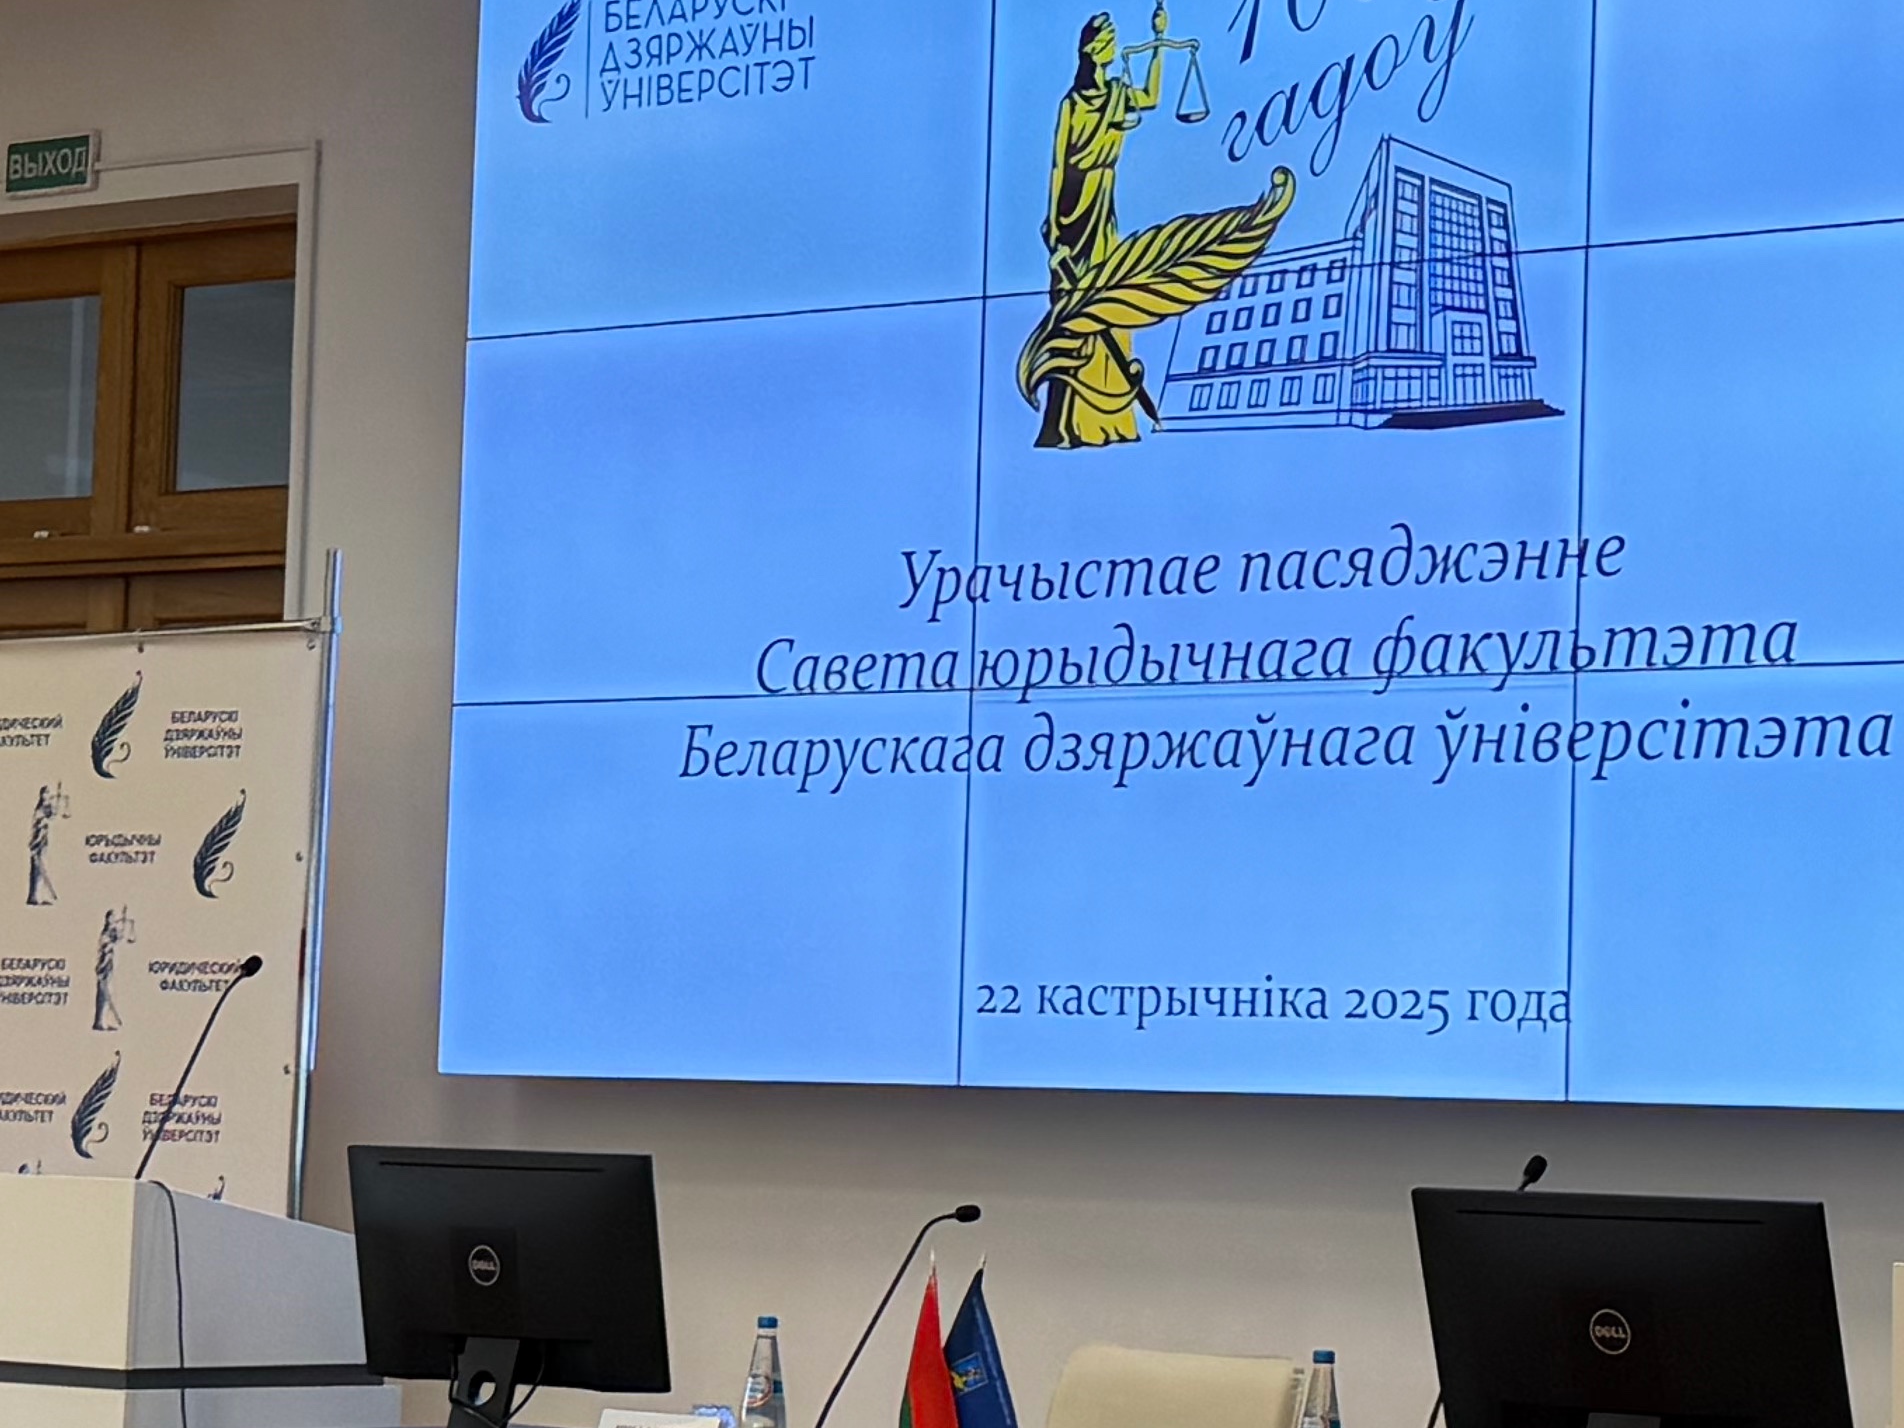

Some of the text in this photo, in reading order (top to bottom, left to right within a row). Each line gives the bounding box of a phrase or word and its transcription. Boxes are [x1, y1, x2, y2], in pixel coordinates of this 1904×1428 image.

[599, 14, 815, 77] ДЗЯРЖАЎНЫ
[599, 55, 817, 113] ЎНІВЕРСІТЭТ
[8, 145, 88, 180] ВЫХОД
[898, 522, 1627, 624] Урачыстае пасяджэнне
[755, 614, 1799, 704] Савета юрыдычнага факультэта
[678, 698, 1894, 795] Беларускага дзяржаўнага ўніверсітэта
[974, 974, 1572, 1036] 22 кастрычніка 2025 года
[1594, 1324, 1627, 1339] DELL
